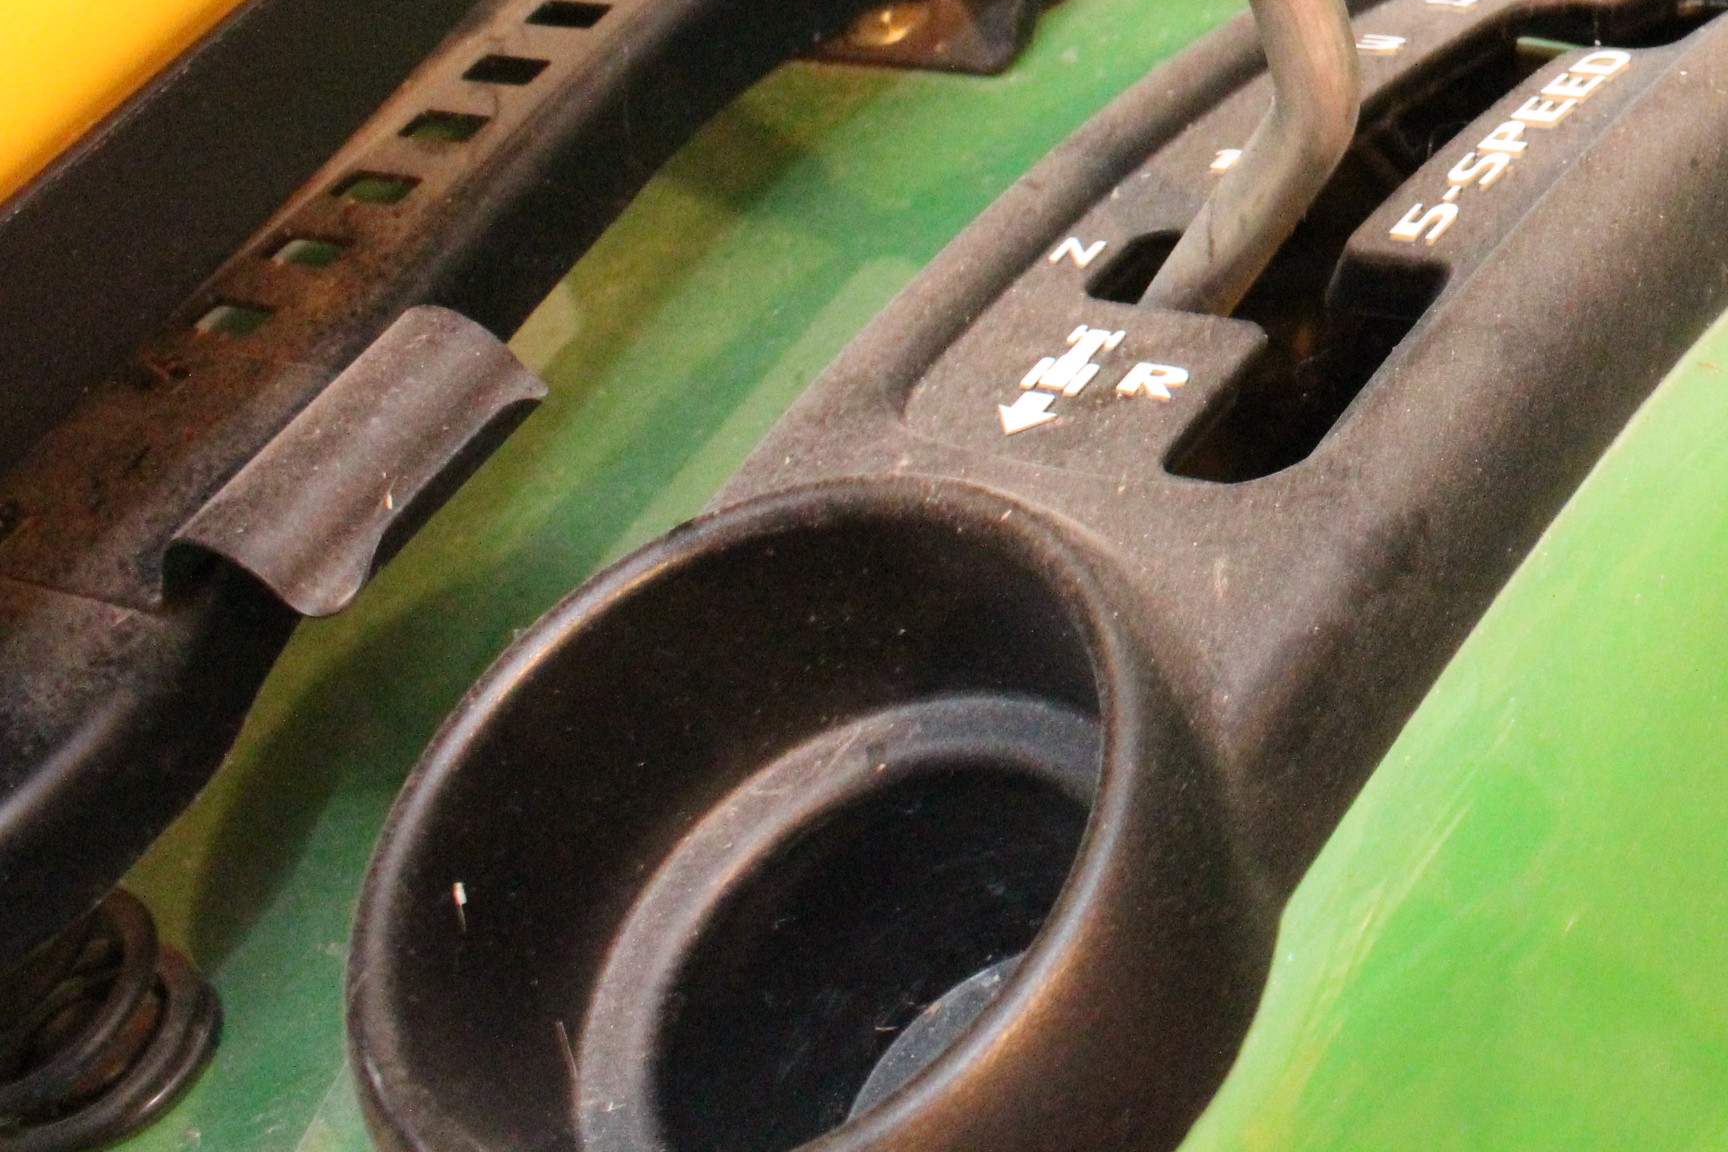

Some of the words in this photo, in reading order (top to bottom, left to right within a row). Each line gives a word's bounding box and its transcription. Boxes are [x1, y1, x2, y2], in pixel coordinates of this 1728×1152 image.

[1389, 49, 1632, 245] 5-SPEED
[1048, 237, 1108, 269] N
[1115, 361, 1190, 401] R
